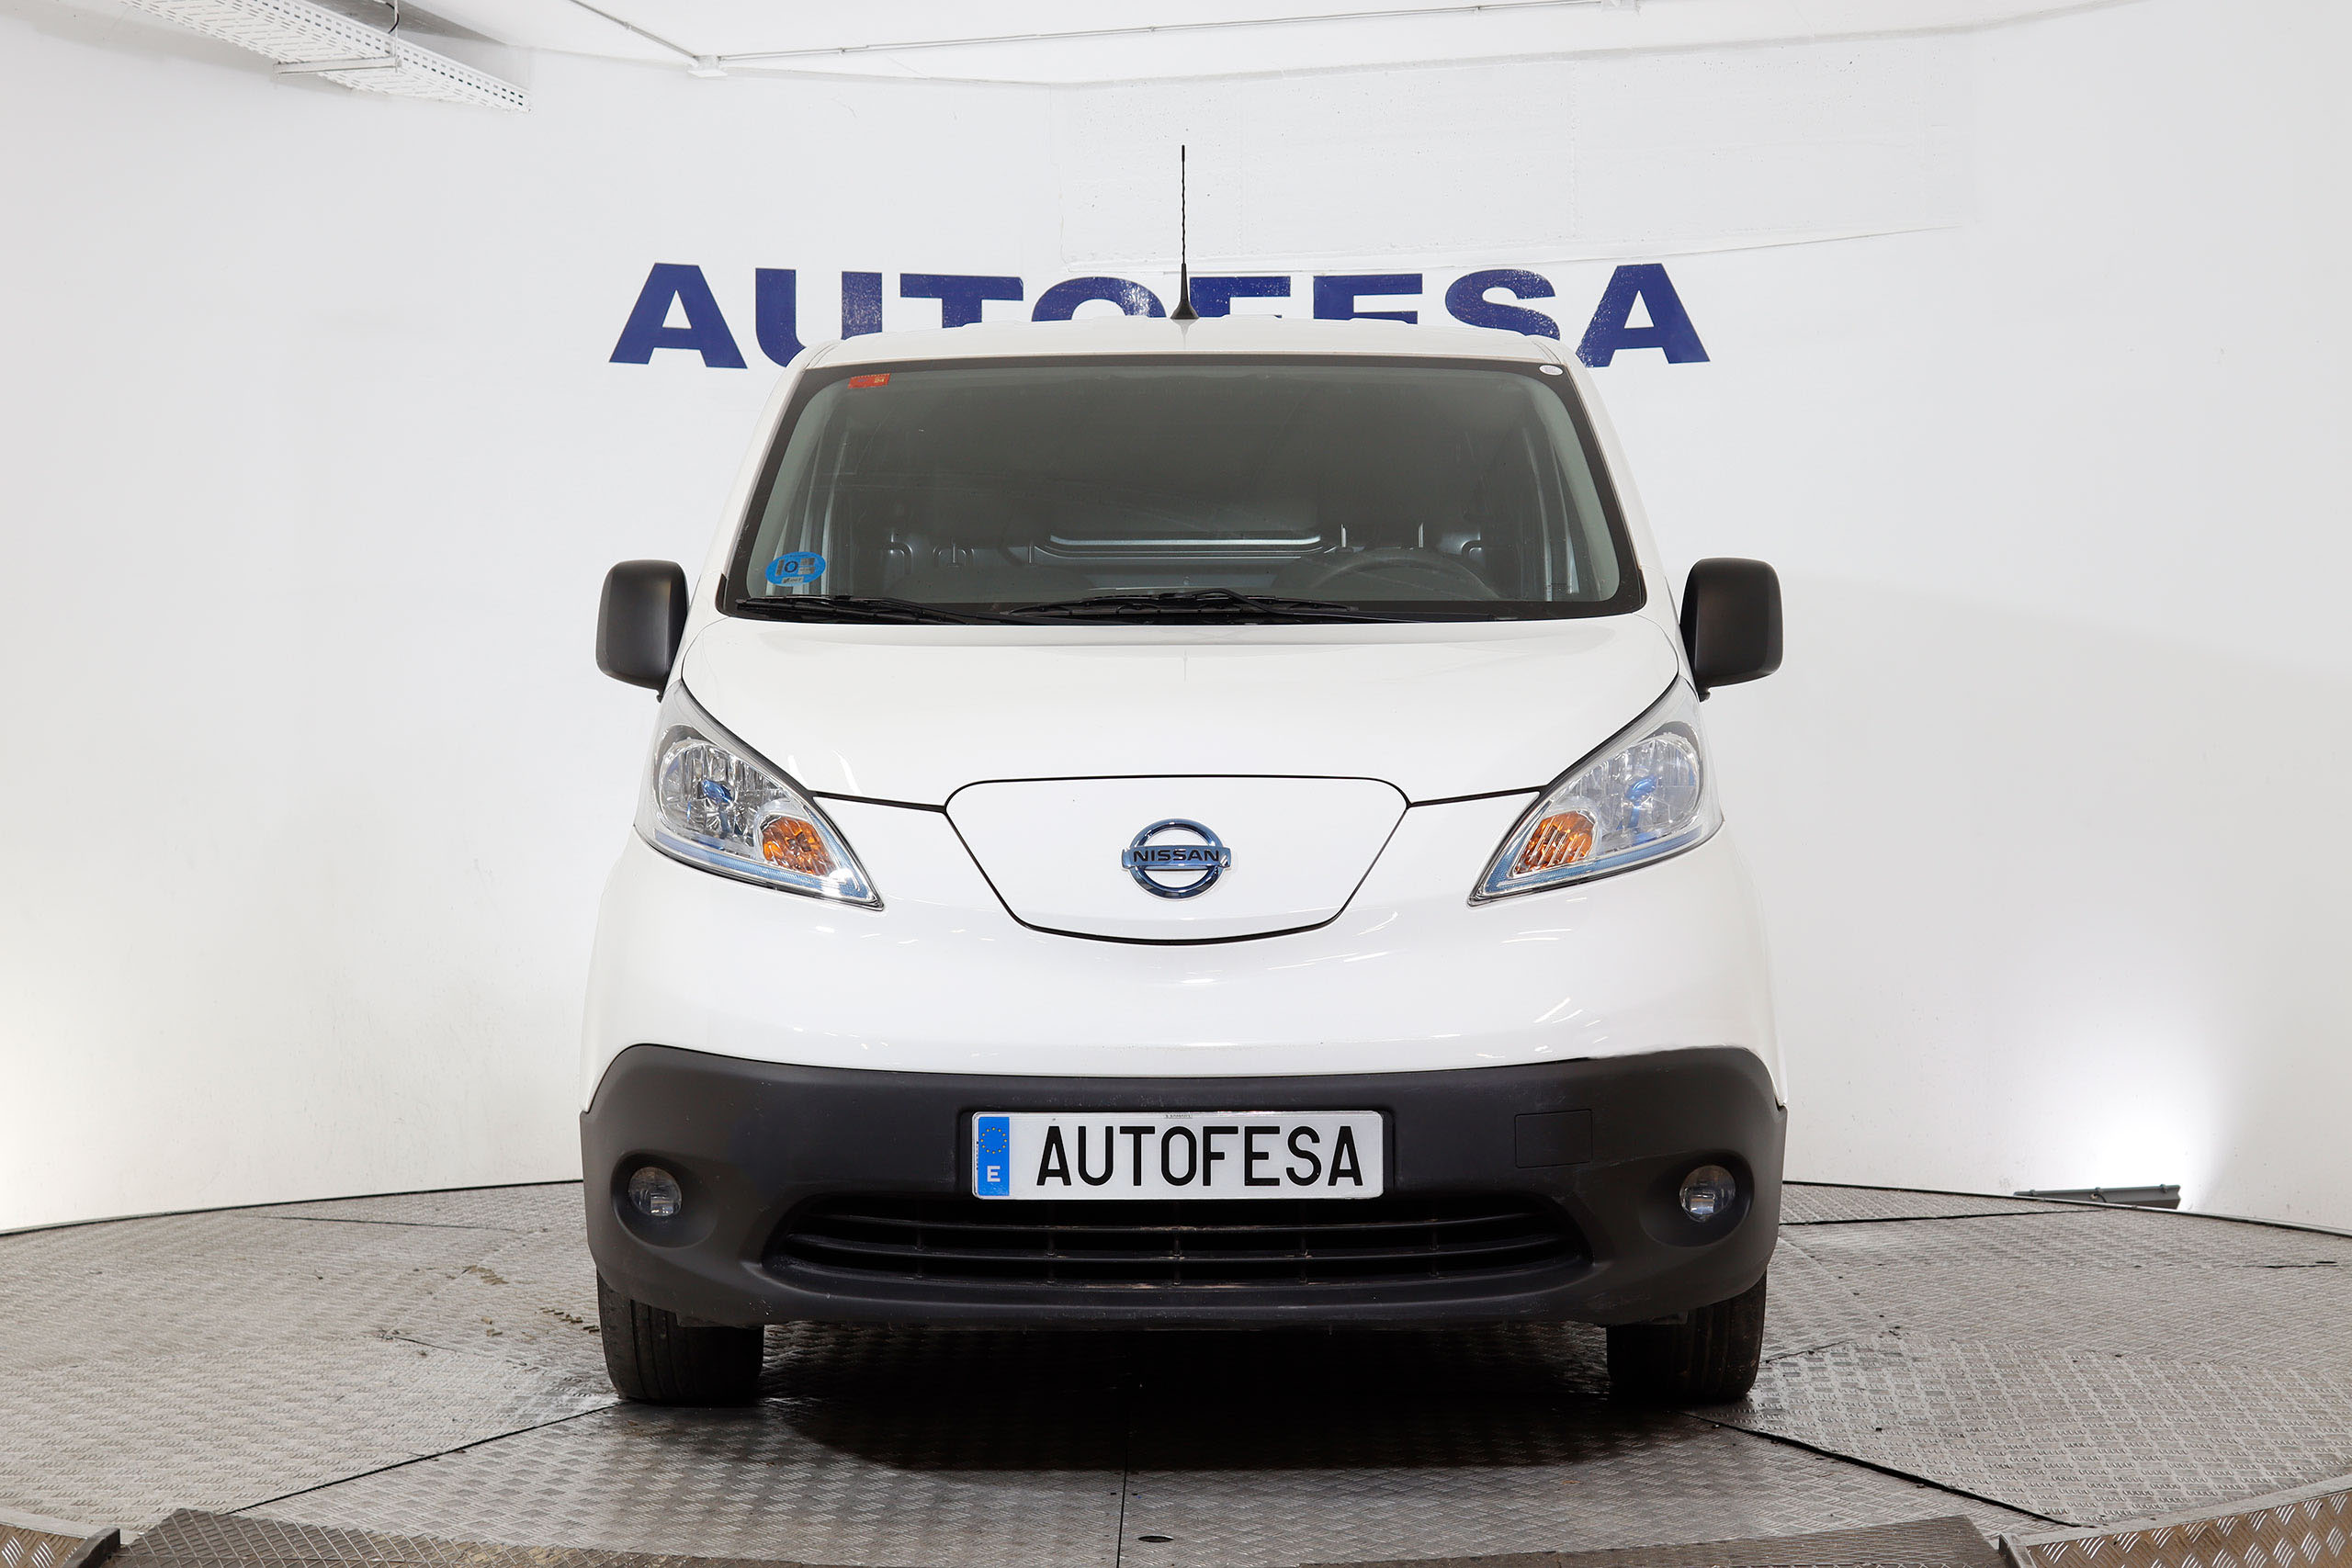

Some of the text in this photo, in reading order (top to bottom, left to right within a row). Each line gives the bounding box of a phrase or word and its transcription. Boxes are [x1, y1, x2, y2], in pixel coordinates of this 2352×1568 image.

[1133, 850, 1220, 863] NISSAN
[987, 1125, 1363, 1187] E AUTOFESA
